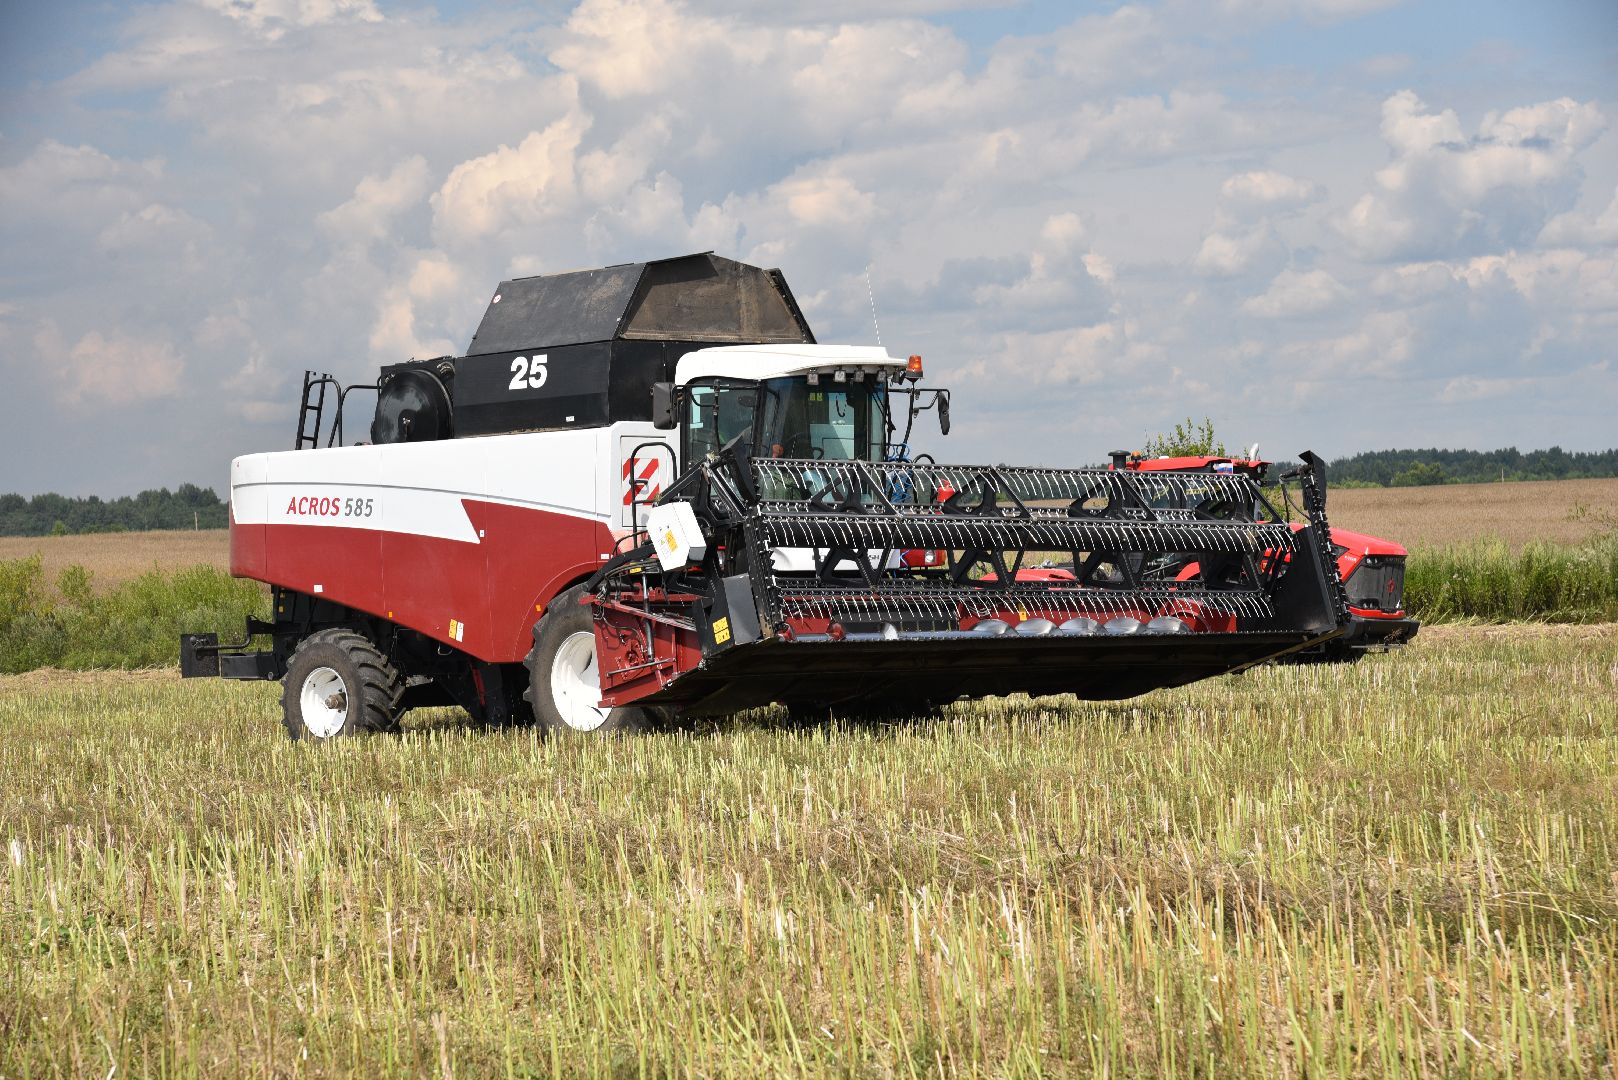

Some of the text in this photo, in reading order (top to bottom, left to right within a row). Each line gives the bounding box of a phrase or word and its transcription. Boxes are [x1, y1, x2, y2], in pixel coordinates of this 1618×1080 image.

[509, 353, 548, 390] 25
[286, 496, 374, 517] ACROS 585
